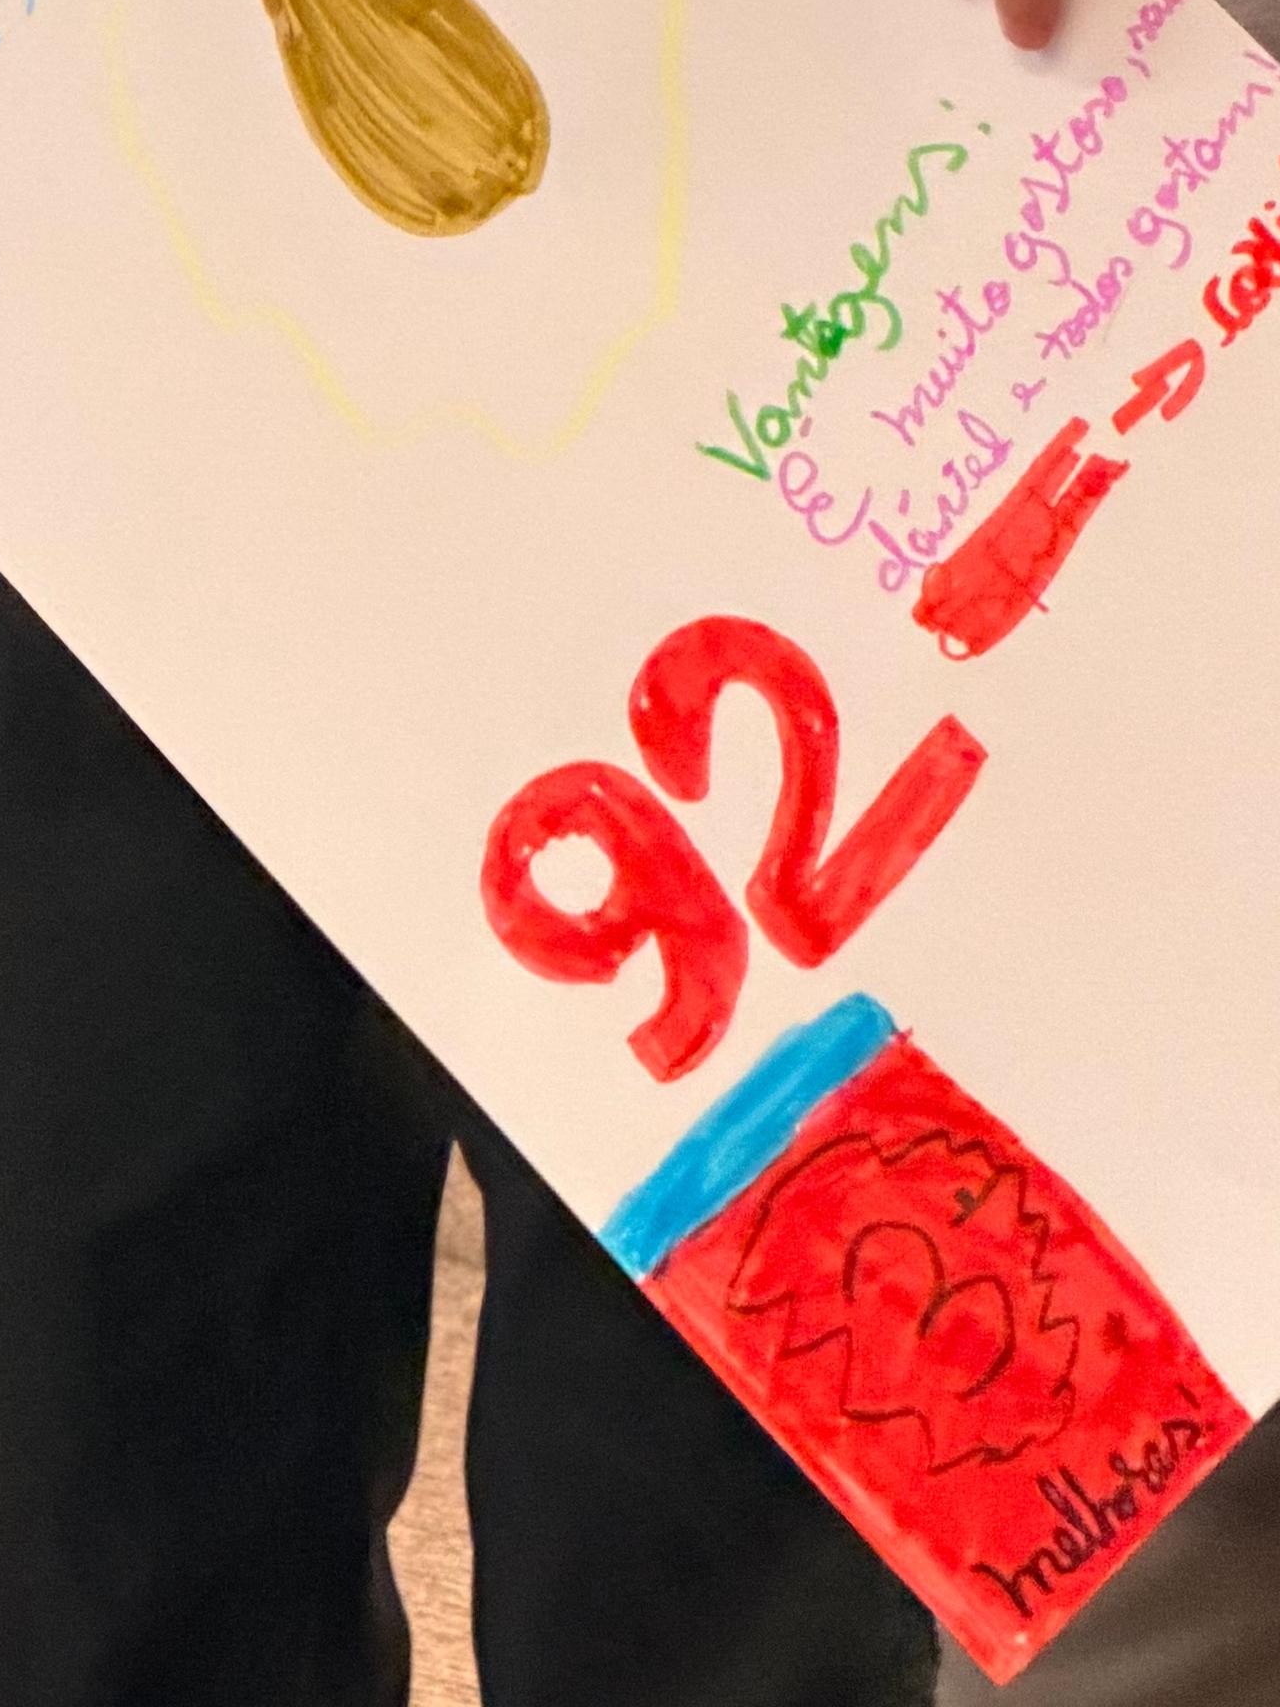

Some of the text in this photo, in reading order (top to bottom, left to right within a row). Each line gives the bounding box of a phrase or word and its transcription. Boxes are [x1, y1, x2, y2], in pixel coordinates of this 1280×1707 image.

[871, 280, 1012, 446] muito
[1035, 255, 1135, 362] todos
[479, 613, 990, 1084] 92
